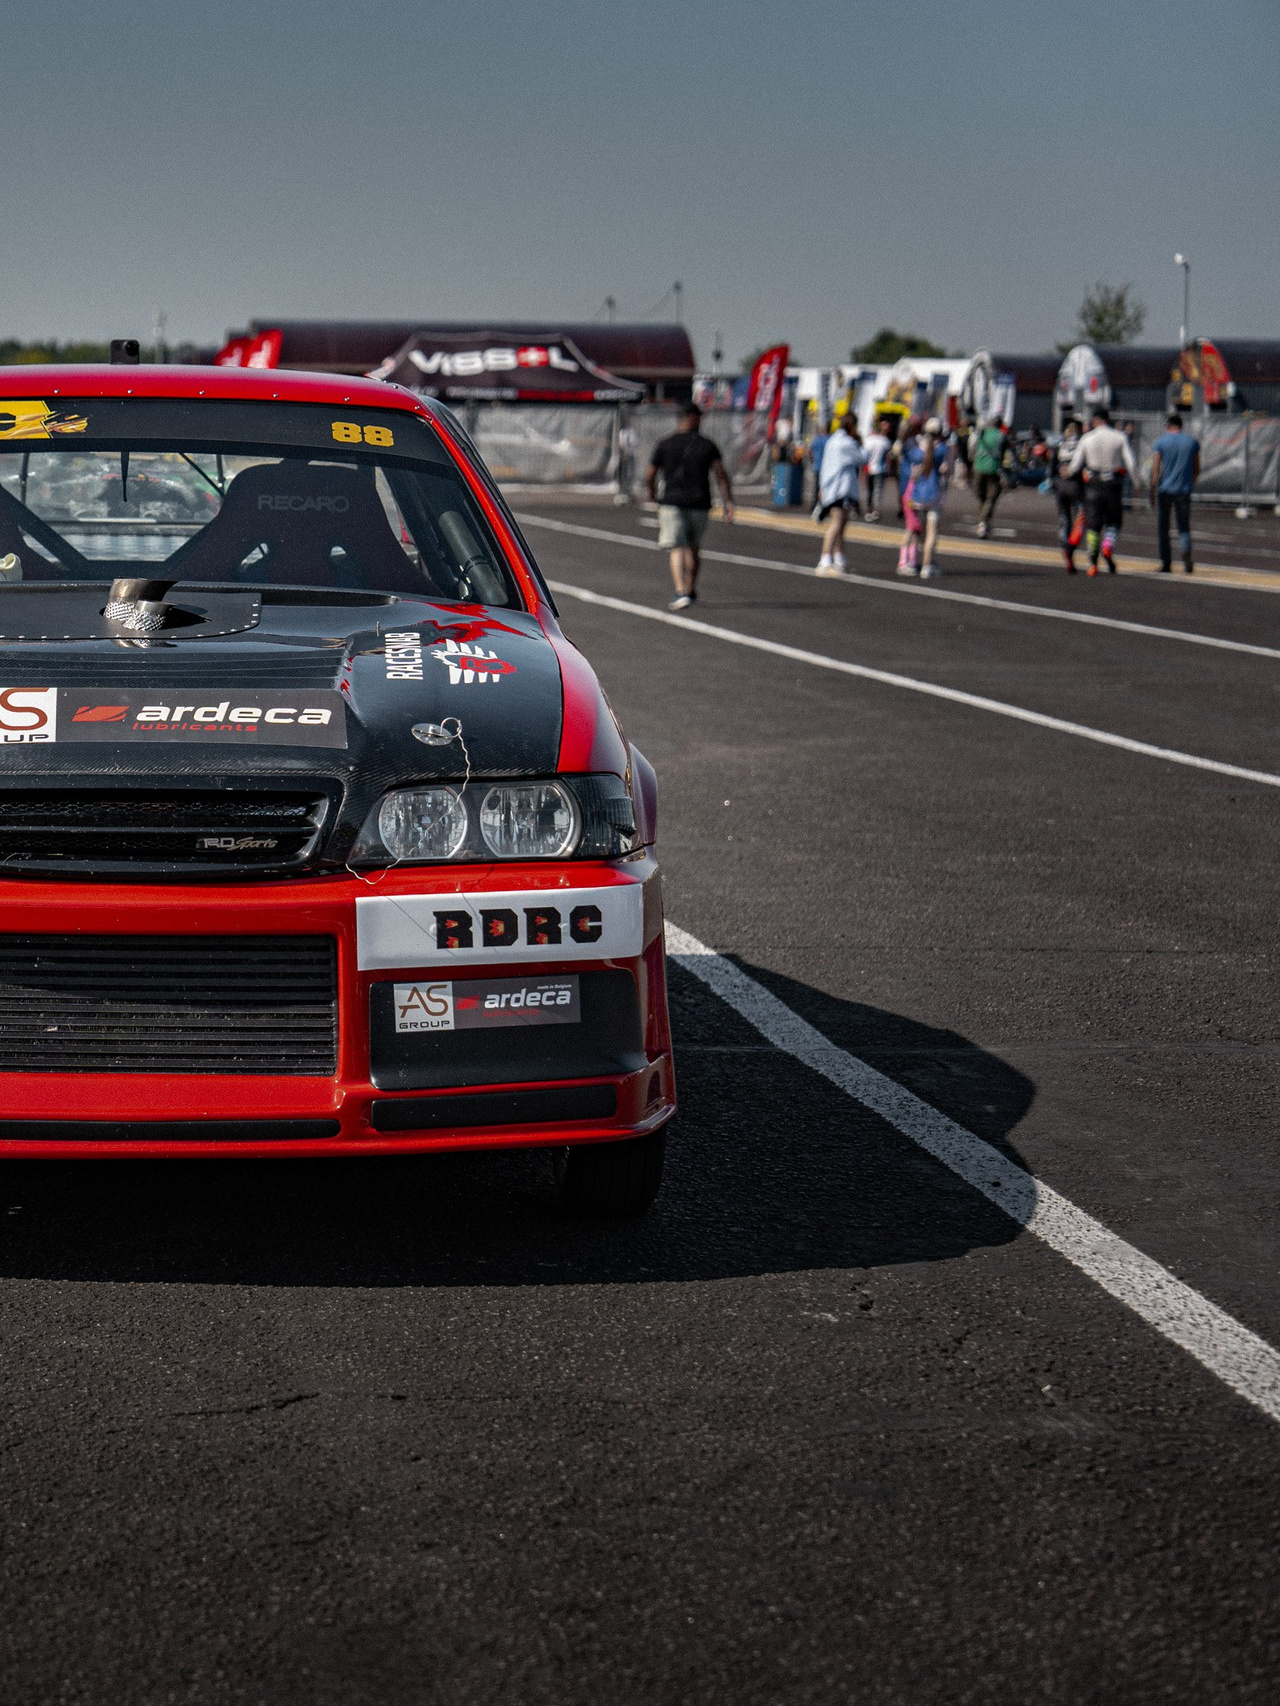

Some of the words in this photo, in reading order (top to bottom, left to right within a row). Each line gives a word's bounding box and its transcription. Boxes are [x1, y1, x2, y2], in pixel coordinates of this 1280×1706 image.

[331, 421, 394, 447] 88
[258, 494, 350, 512] RECARO
[384, 632, 424, 680] RACESNAB
[136, 701, 332, 725] ardeca
[132, 722, 258, 732] lubricants
[432, 904, 603, 950] RDRC
[398, 984, 448, 1018] AS
[484, 988, 571, 1008] ardeca
[399, 1020, 450, 1029] GROUP
